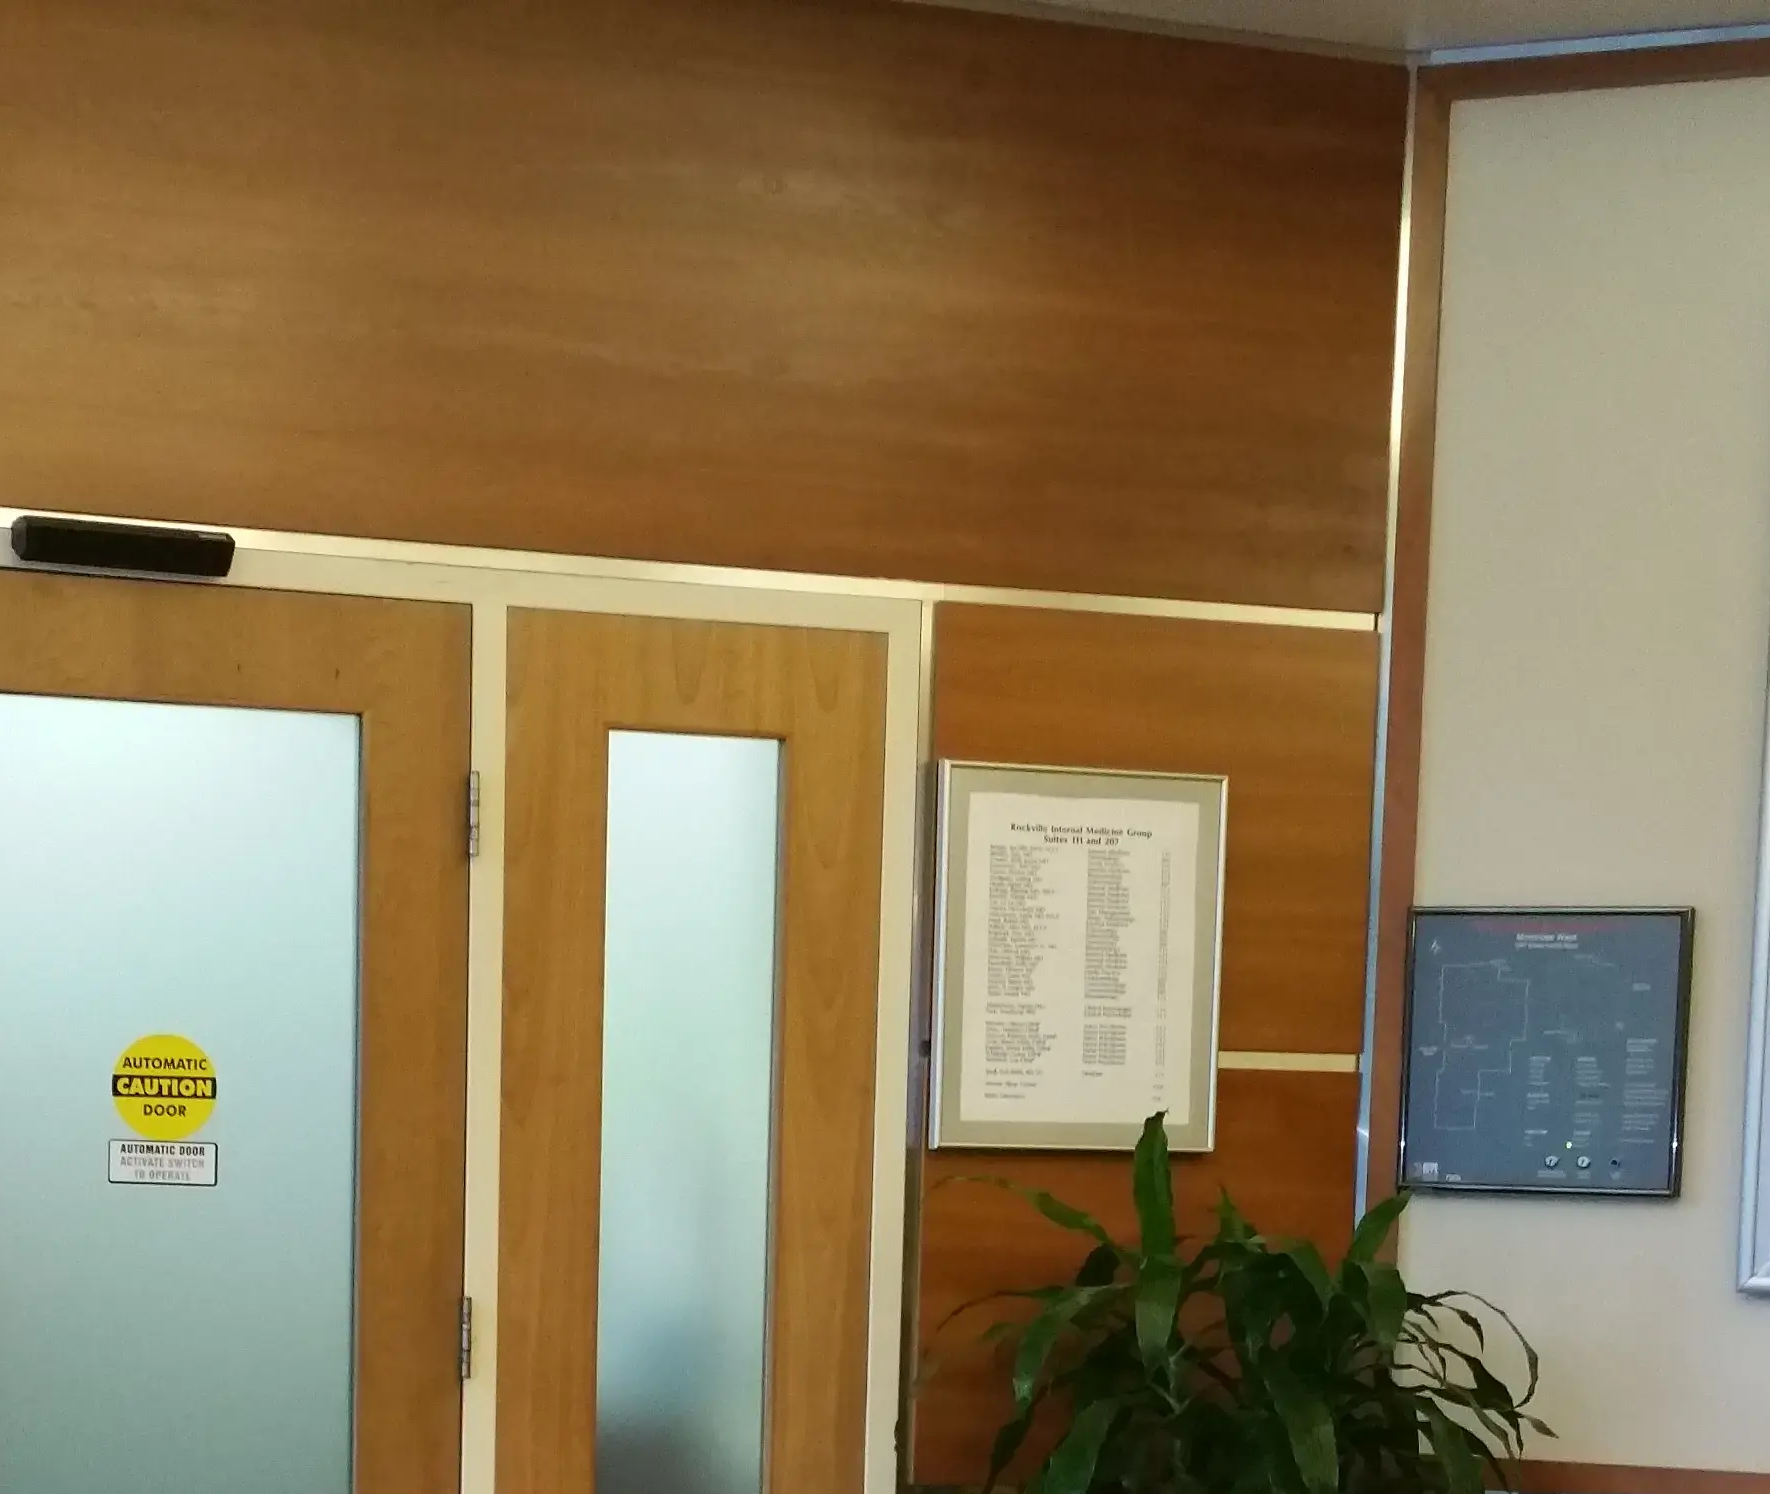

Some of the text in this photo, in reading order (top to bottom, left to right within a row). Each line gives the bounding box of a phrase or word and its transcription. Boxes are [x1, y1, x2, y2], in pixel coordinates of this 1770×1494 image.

[123, 1057, 208, 1070] AUTOMATIC
[117, 1077, 212, 1097] CAUTION
[143, 1104, 186, 1117] DOOR
[120, 1144, 205, 1156] AUTOMATIC DOOR
